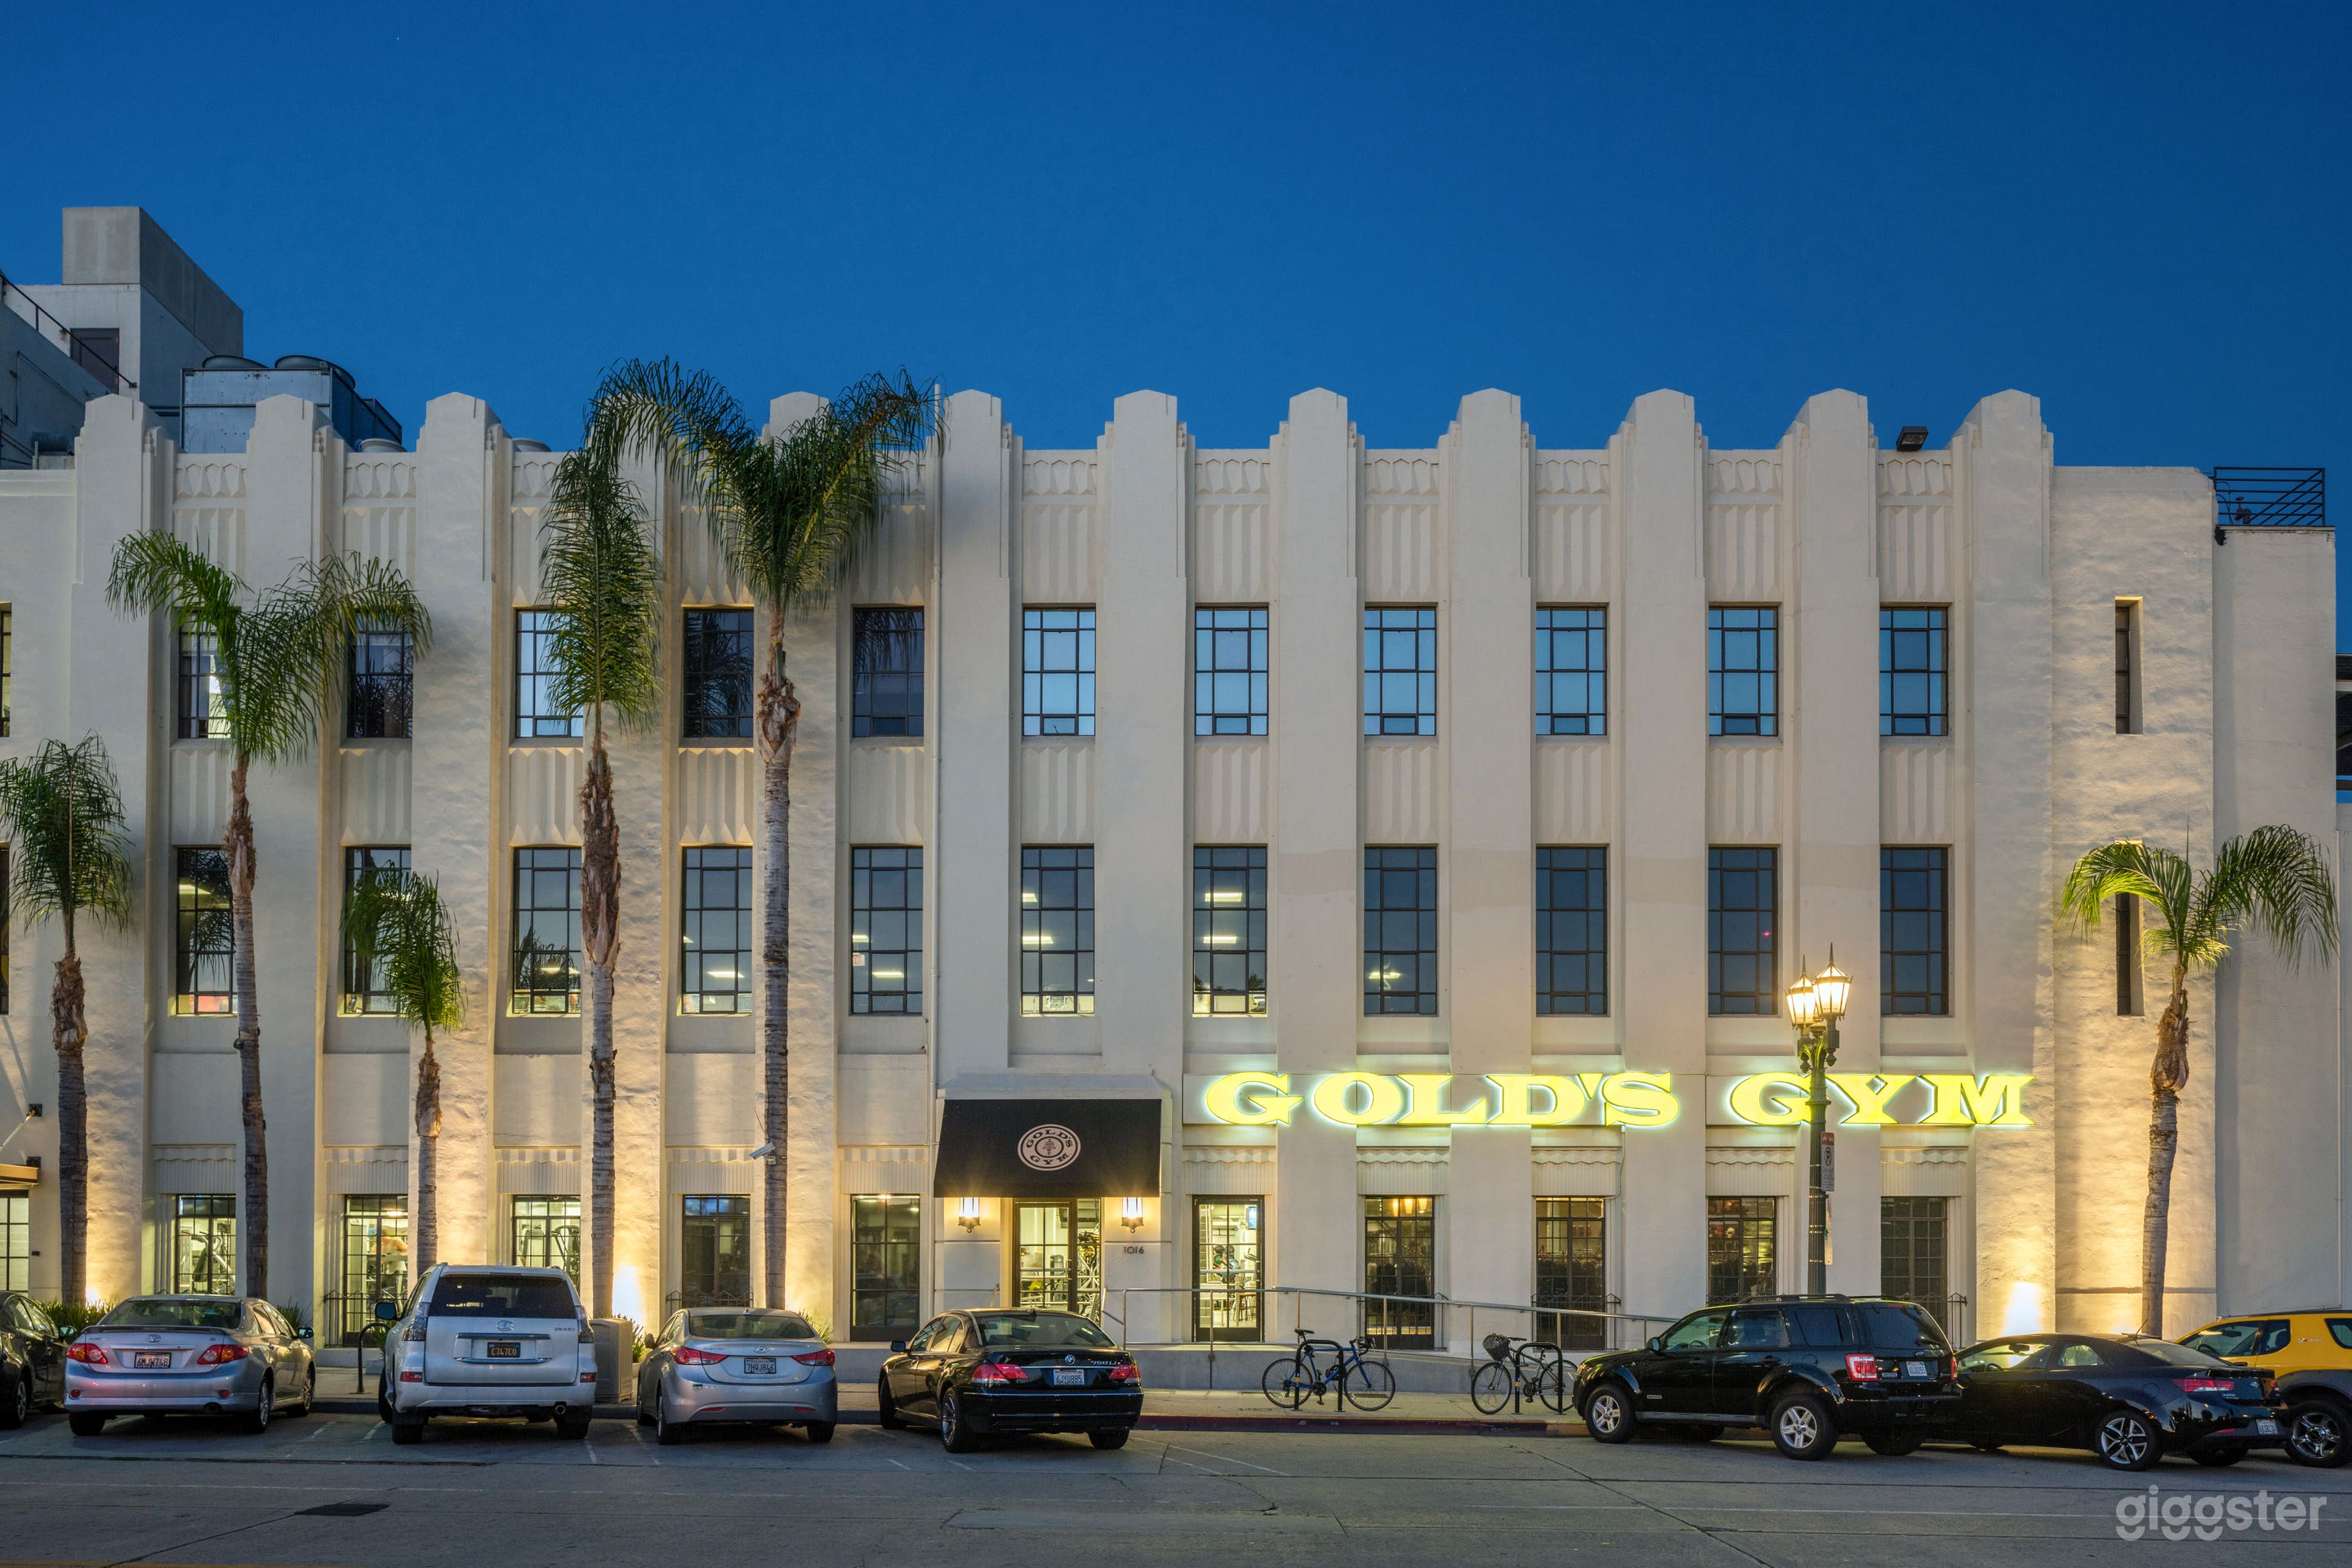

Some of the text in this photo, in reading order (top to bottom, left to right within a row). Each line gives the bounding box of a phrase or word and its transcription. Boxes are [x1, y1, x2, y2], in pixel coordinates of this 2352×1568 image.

[1205, 1071, 2037, 1126] GOLD'S GYM
[1026, 1129, 1073, 1148] GOLD'S
[1030, 1152, 1070, 1165] GYM
[1123, 1245, 1145, 1254] 1016
